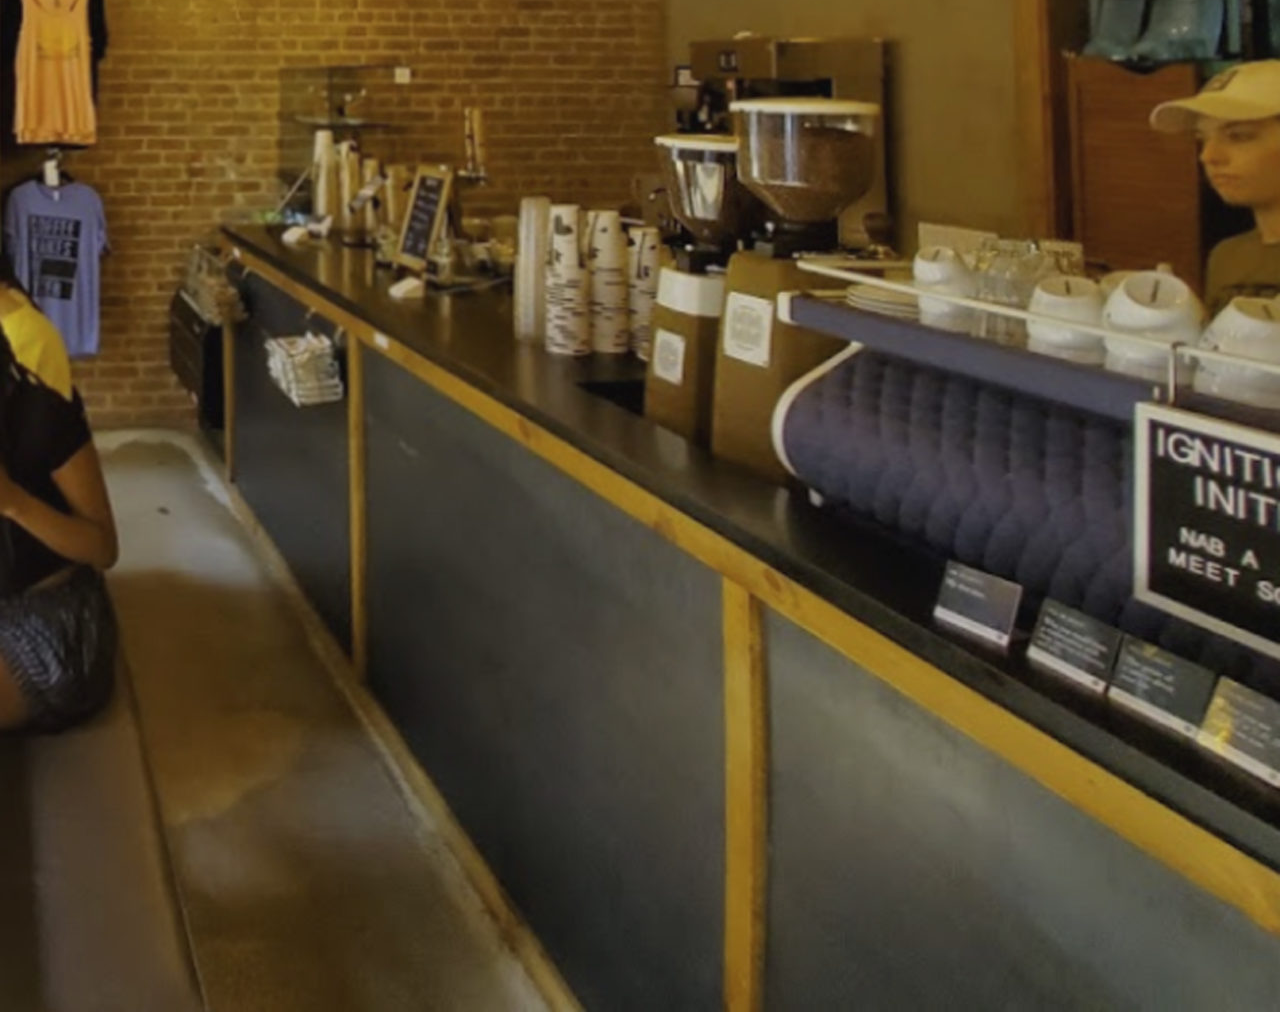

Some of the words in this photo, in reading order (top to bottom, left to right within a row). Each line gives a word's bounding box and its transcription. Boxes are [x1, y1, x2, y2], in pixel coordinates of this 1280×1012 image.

[1157, 427, 1280, 489] IGNITI
[1168, 547, 1240, 587] MEET
[1179, 527, 1225, 558] NAB
[1241, 549, 1260, 570] A
